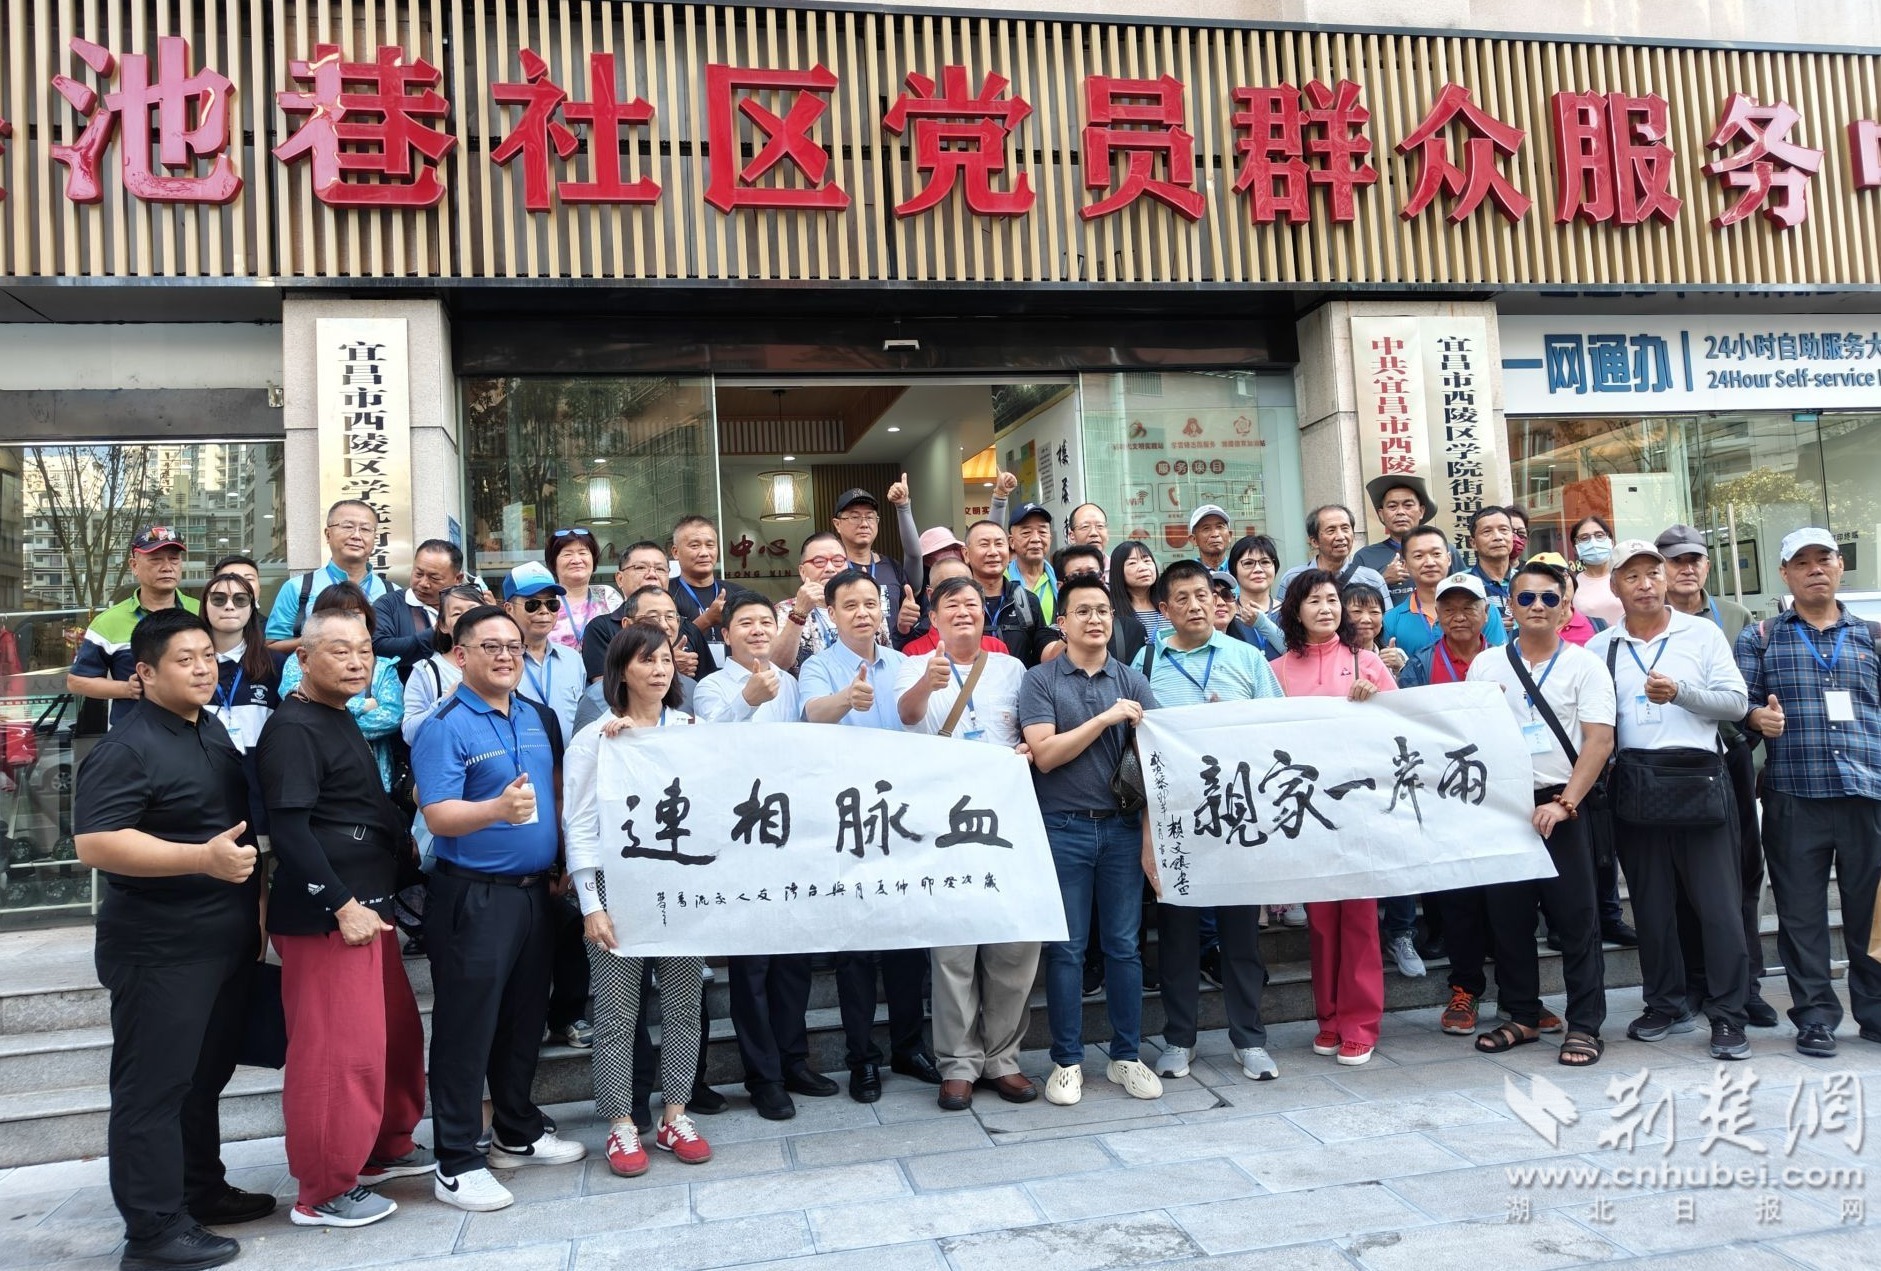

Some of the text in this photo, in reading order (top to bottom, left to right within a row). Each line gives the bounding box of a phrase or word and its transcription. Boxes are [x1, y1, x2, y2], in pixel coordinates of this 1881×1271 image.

[0, 34, 1881, 234] 池巷社区党员群众服务
[1502, 333, 1674, 395] 一网通办
[1707, 368, 1772, 390] 24Hour
[1775, 366, 1875, 389] Self-service
[1157, 460, 1225, 476] 服务项目
[729, 534, 790, 569] 中心
